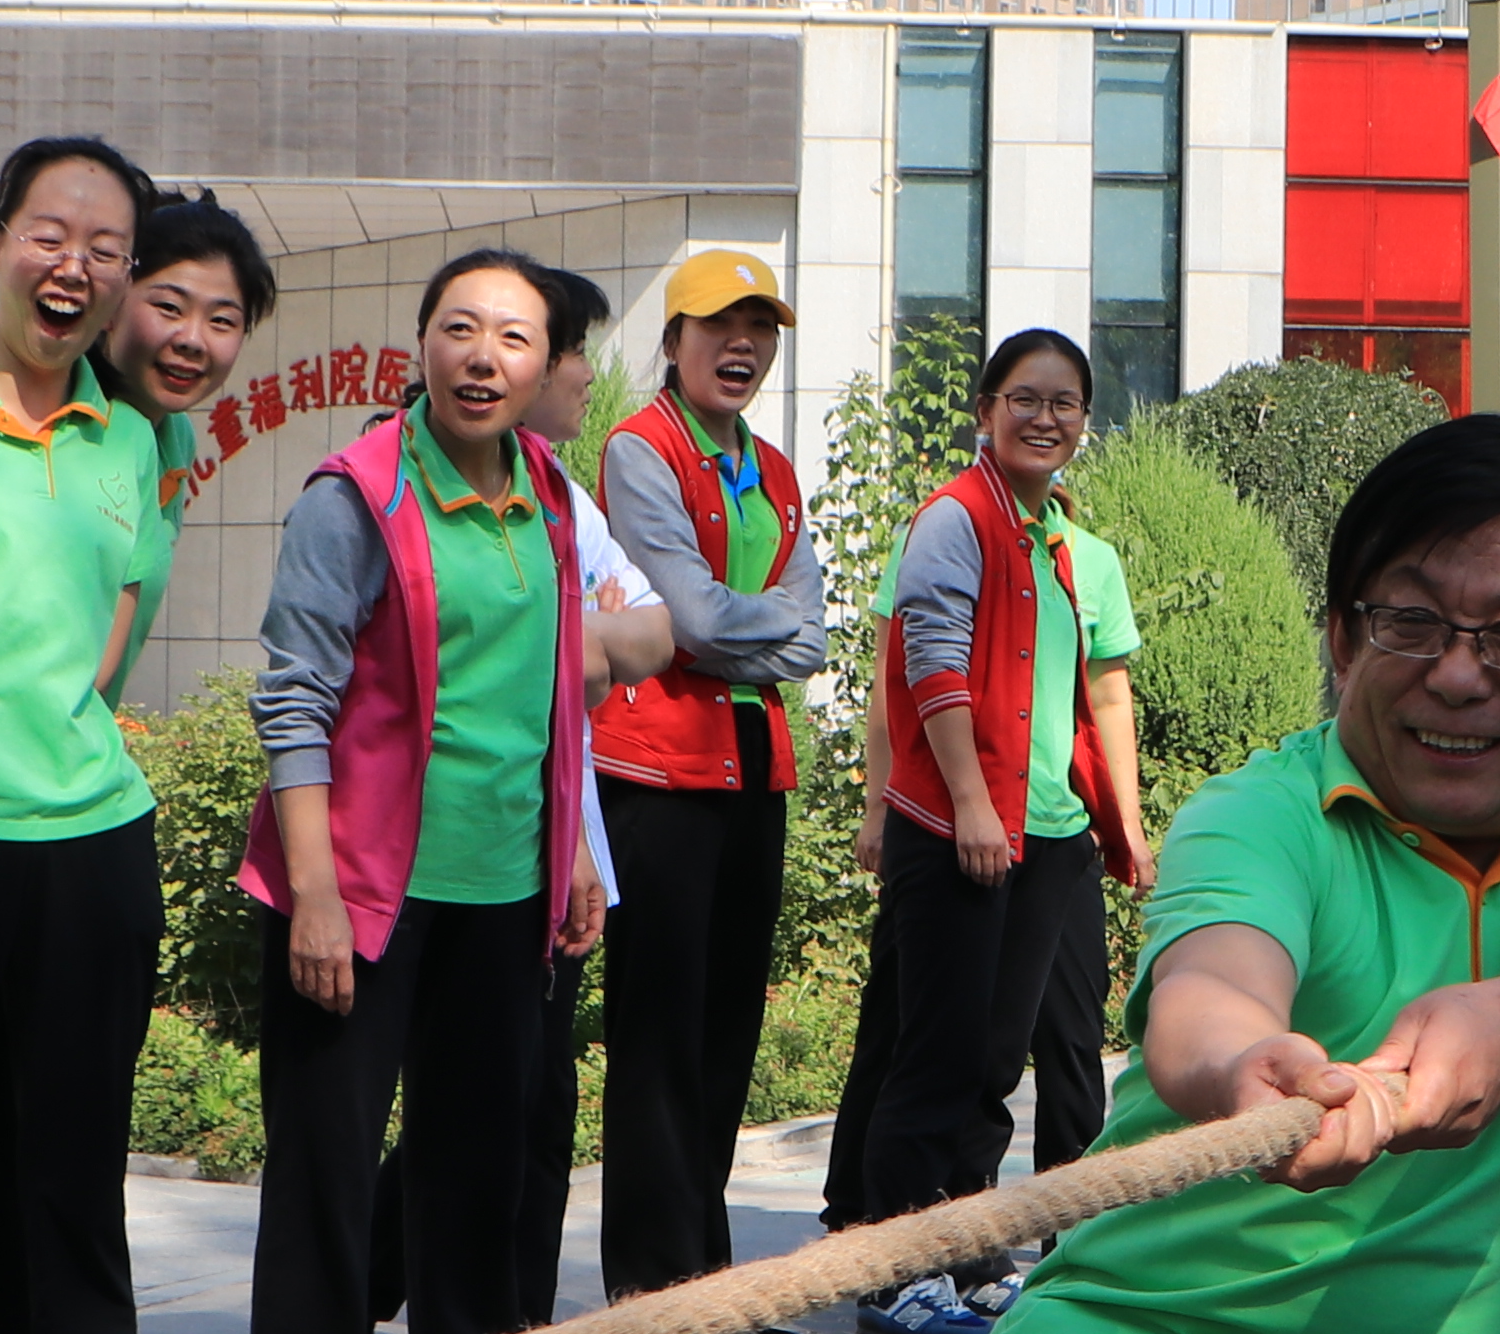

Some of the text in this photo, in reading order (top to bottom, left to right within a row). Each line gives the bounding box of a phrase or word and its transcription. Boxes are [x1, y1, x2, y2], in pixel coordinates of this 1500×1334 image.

[184, 342, 411, 509] 儿童福利院医
